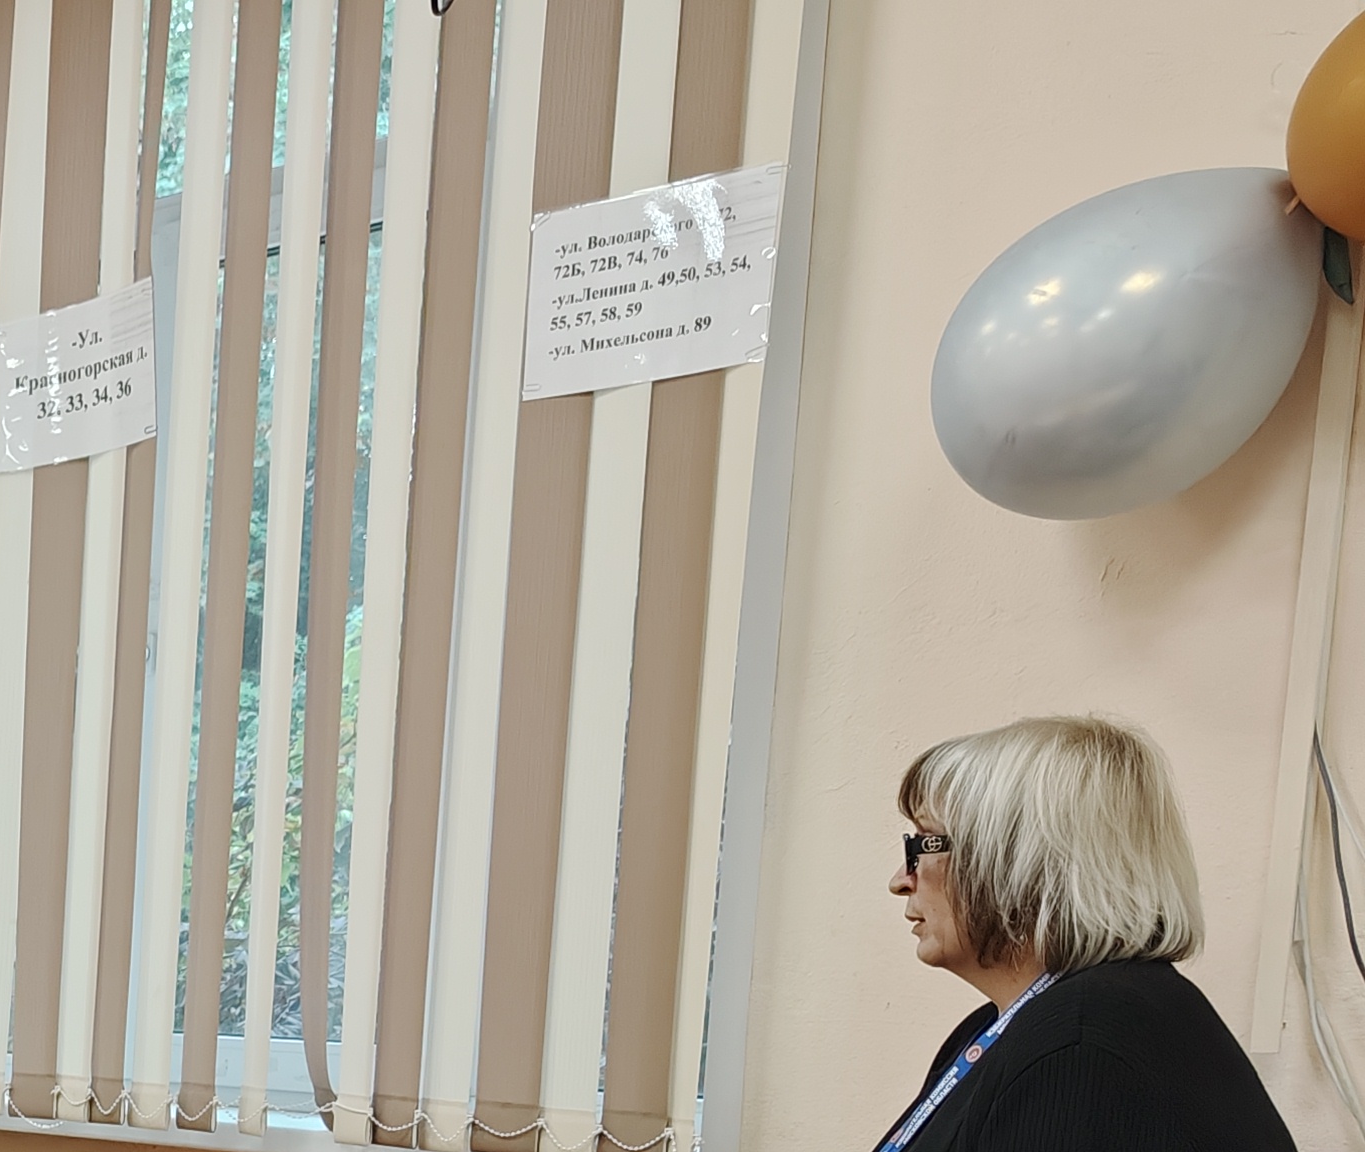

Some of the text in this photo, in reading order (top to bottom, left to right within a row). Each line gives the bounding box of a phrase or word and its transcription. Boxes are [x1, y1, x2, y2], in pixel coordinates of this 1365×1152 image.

[553, 245, 669, 281] 72Б, 72В, 74, 76
[554, 240, 583, 259] -ул.
[640, 278, 654, 294] д.
[704, 260, 726, 278] 53,
[730, 255, 751, 273] 54,
[549, 301, 643, 332] 55, 57, 58, 59
[71, 328, 103, 350] -Ул.
[136, 345, 148, 364] д.
[548, 315, 712, 361] -ул. Михельсона д. 89
[37, 378, 132, 420] 32, 33, 34, 36
